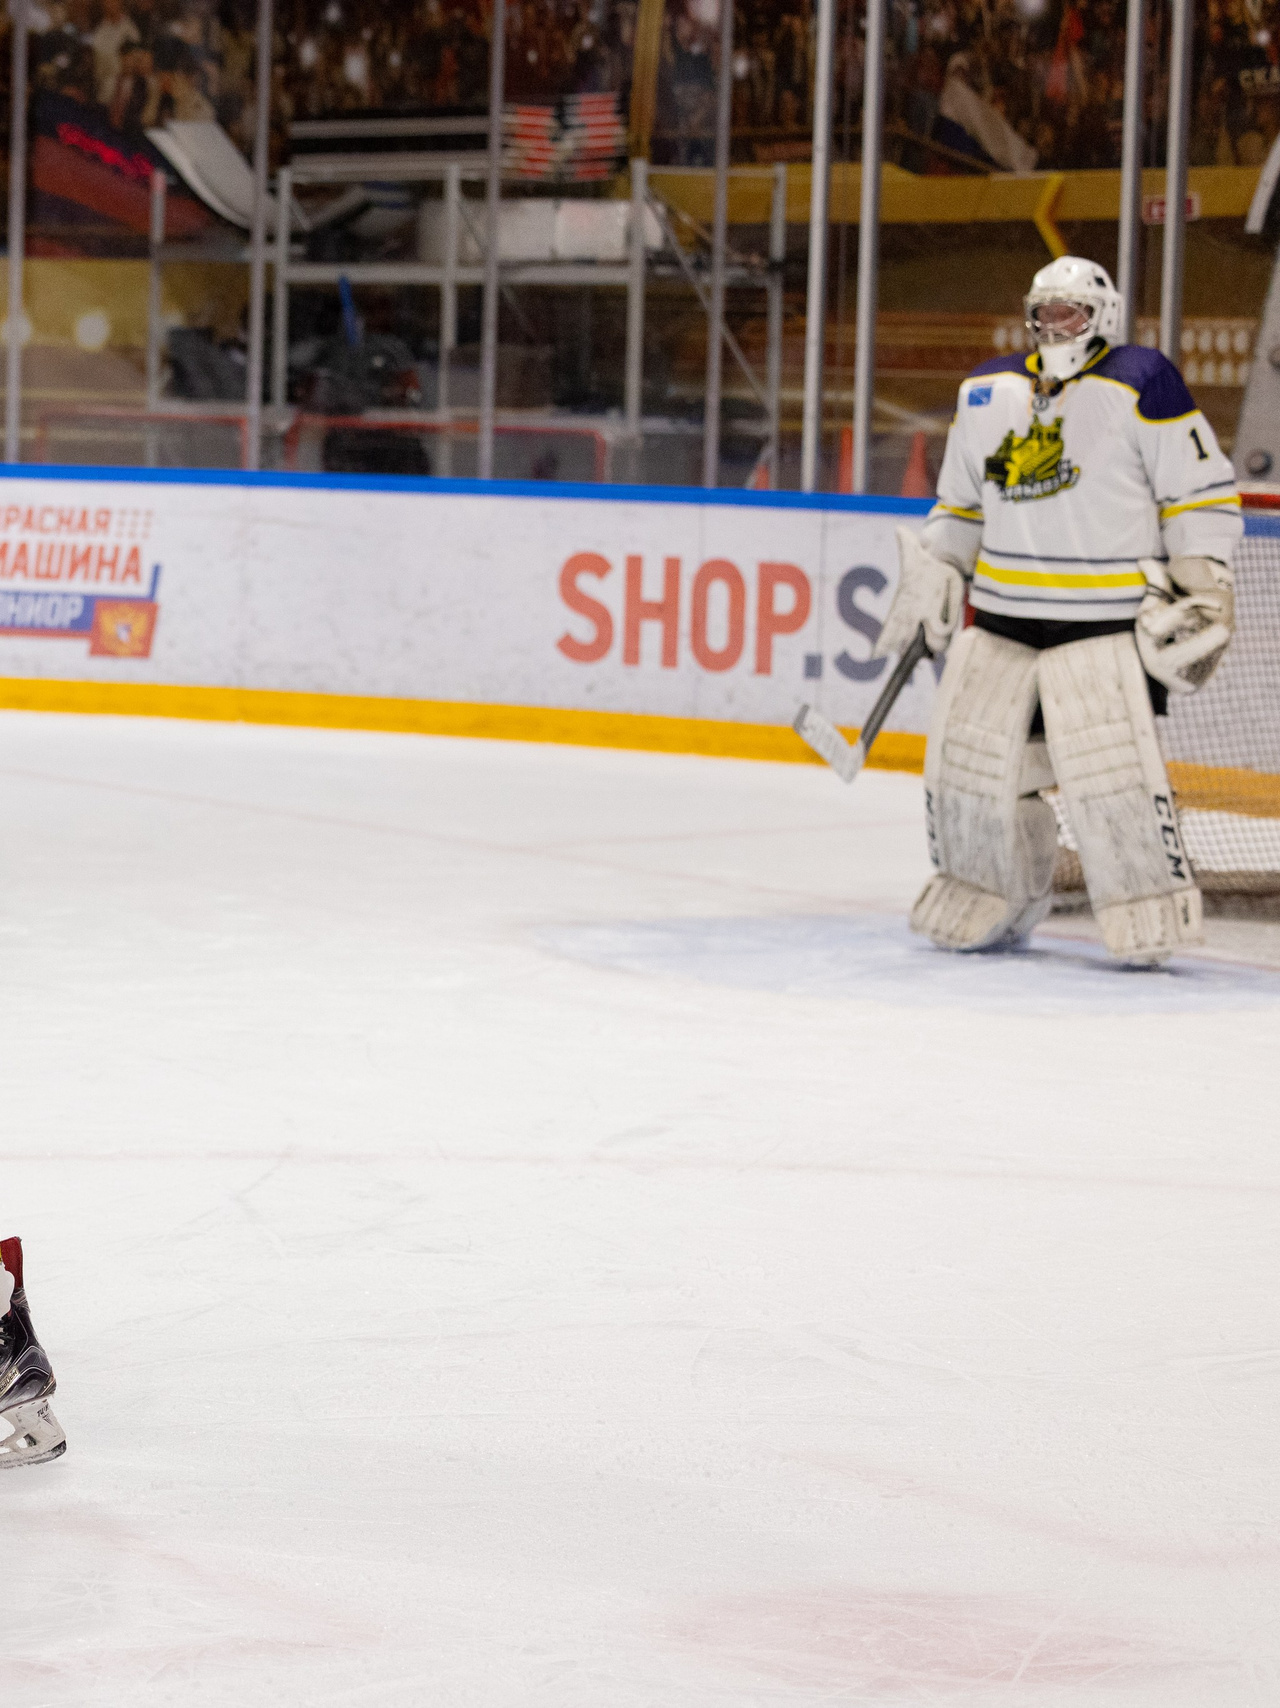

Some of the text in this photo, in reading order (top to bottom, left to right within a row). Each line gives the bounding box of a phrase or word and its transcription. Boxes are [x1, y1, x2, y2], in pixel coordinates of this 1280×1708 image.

[1190, 428, 1208, 460] 1
[556, 551, 947, 687] SHOP.S
[1154, 793, 1187, 881] CCM
